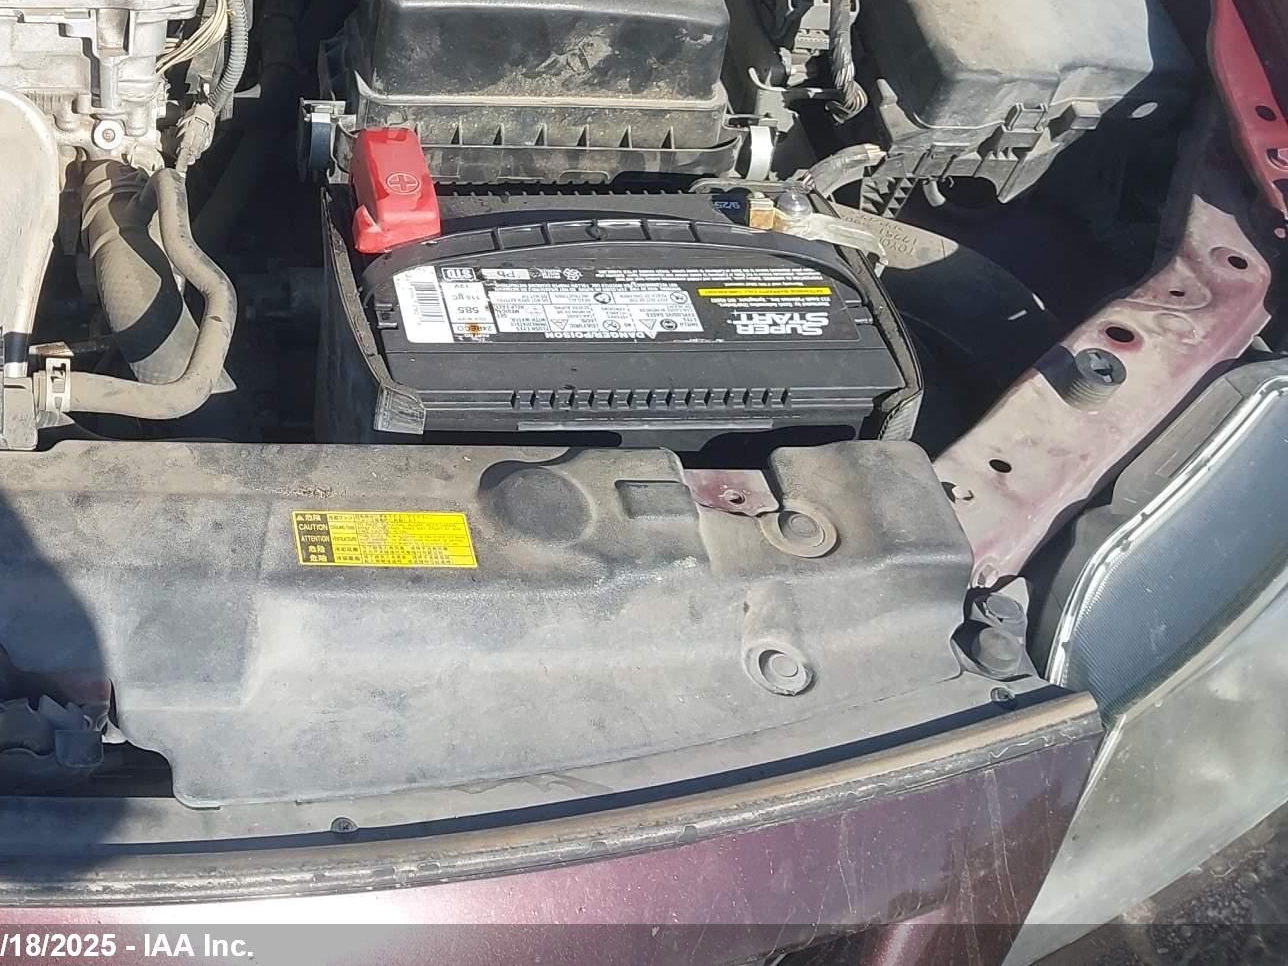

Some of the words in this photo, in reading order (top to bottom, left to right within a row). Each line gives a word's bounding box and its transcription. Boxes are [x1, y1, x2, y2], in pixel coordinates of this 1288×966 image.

[497, 270, 516, 278] Pb
[457, 306, 479, 314] 585
[732, 312, 829, 326] START
[735, 324, 823, 336] SUPER
[298, 523, 328, 531] CAUTION
